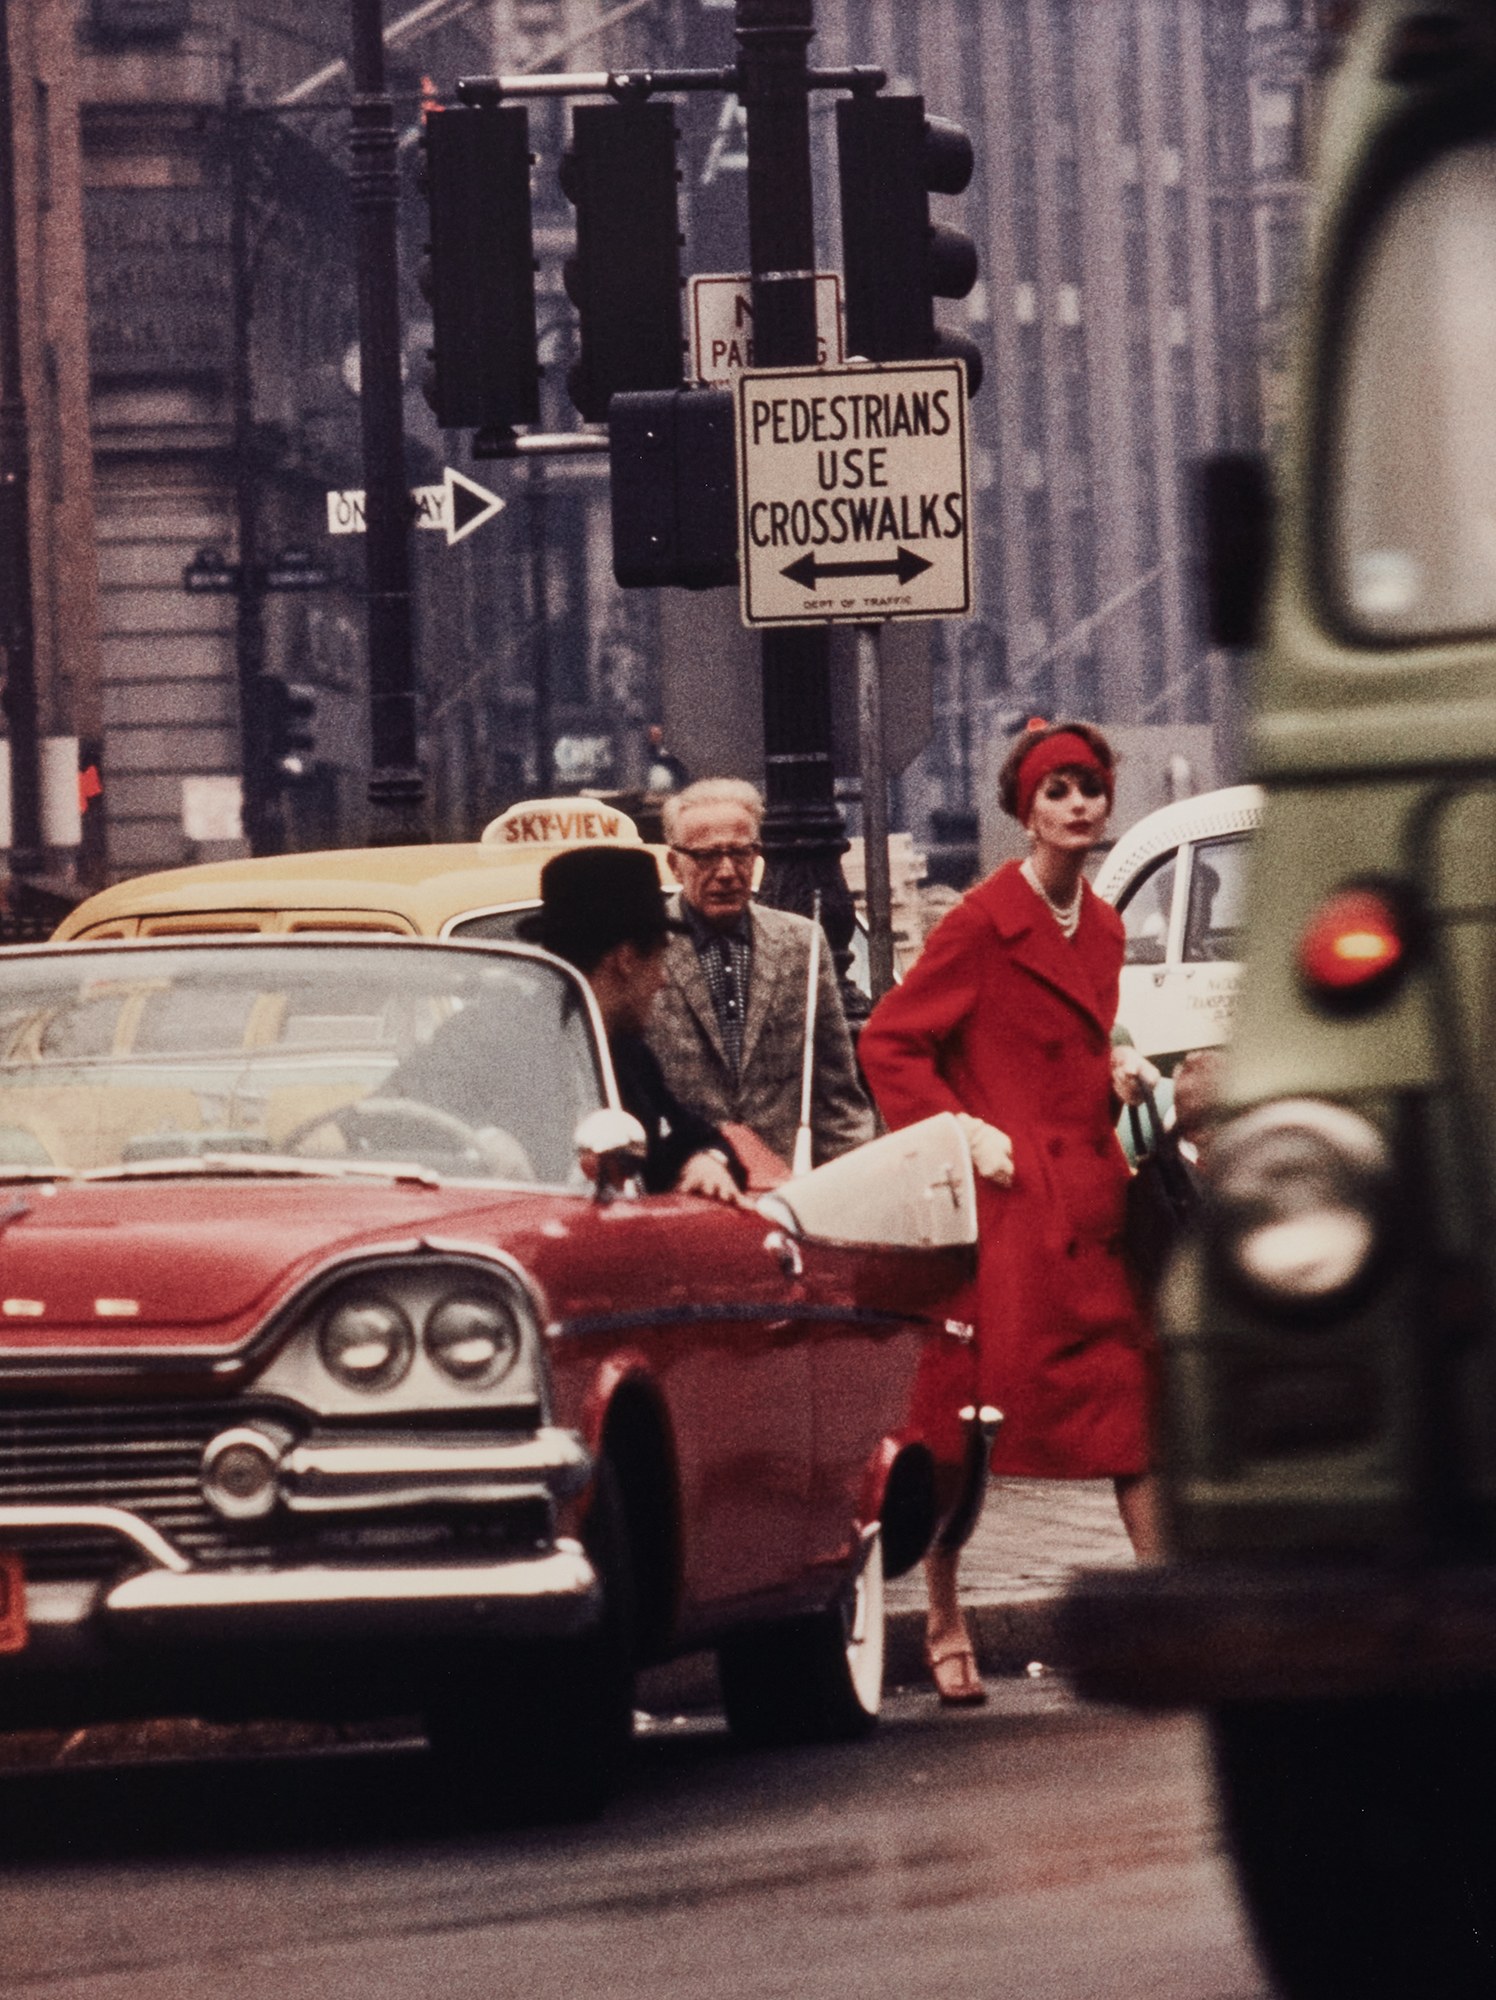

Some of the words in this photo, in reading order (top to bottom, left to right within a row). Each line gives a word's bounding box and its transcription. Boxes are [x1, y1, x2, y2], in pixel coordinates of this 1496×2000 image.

[753, 390, 951, 445] PEDESTRIANS
[817, 447, 888, 490] USE
[750, 493, 962, 547] CROSSWALKS
[841, 599, 856, 608] OF
